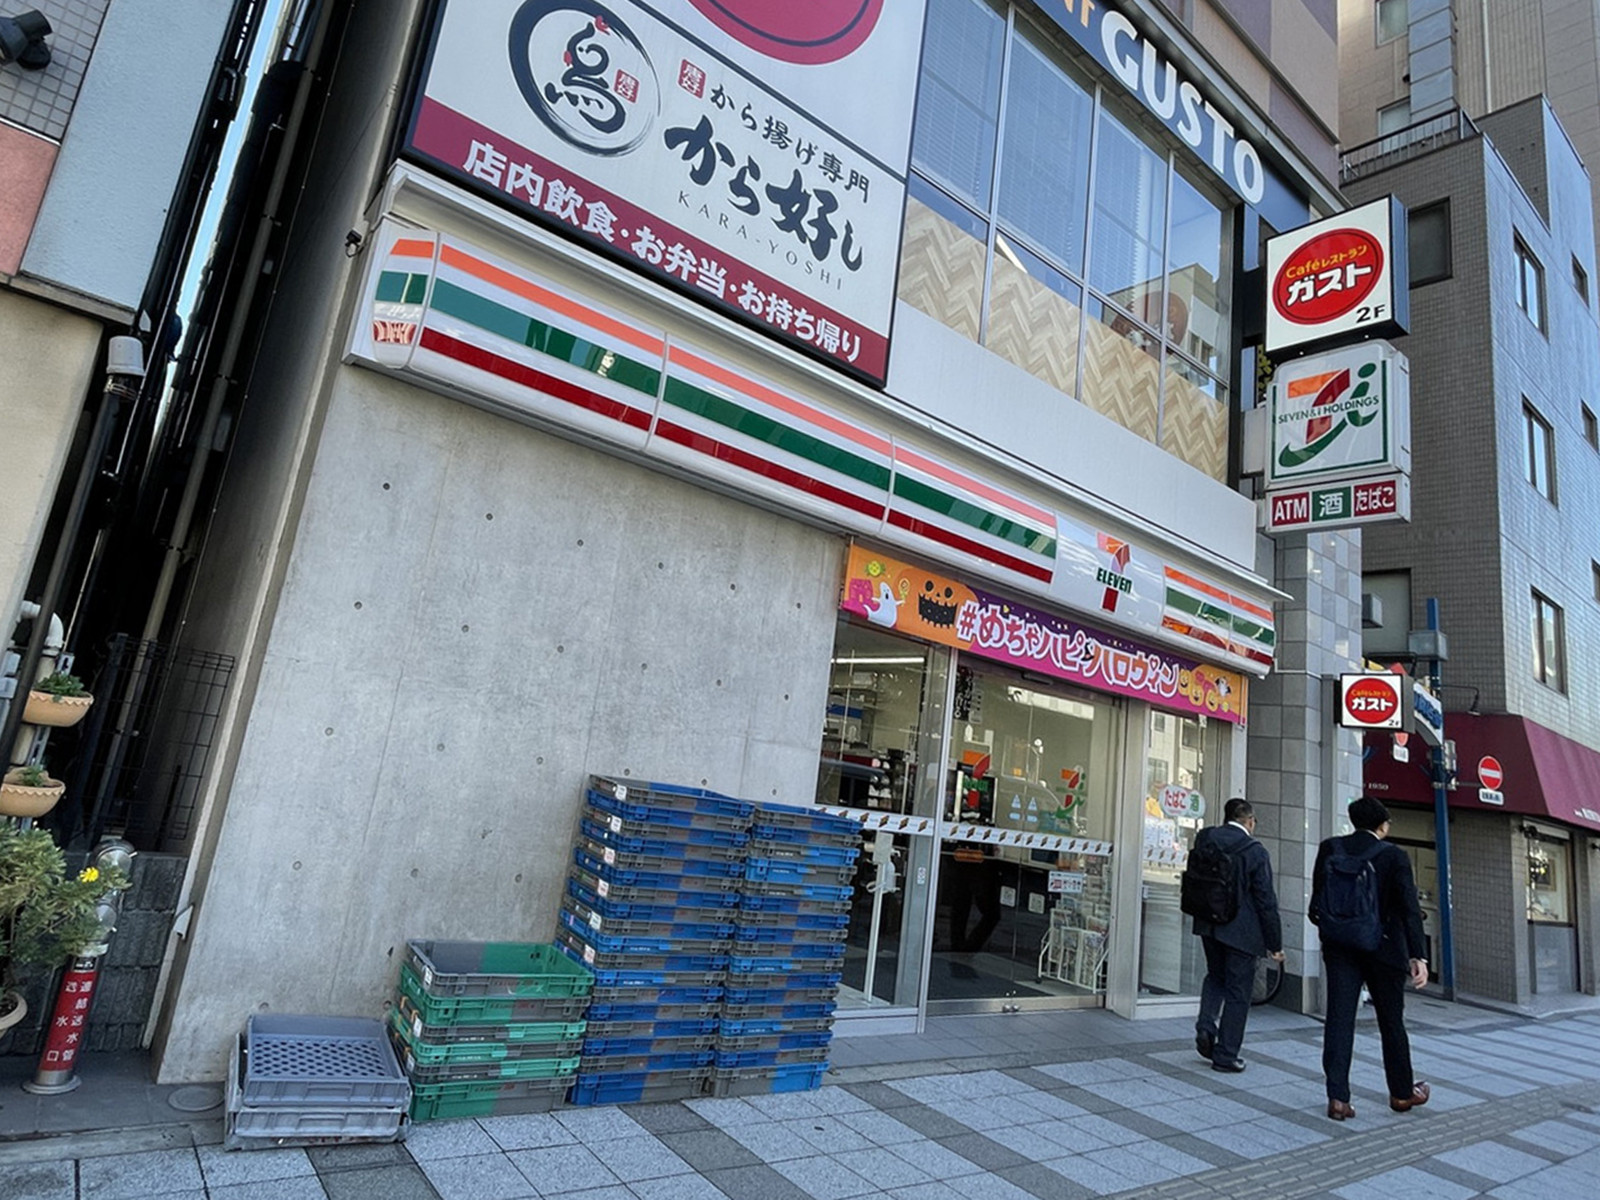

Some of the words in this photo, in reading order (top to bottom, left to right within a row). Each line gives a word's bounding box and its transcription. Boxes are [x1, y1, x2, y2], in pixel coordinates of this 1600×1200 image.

[1101, 10, 1264, 203] GUSTO
[710, 84, 869, 203] から揚げ専門
[664, 114, 863, 272] から好し
[678, 190, 842, 290] KARA-YOSHI
[1287, 262, 1372, 306] ガスト
[1356, 304, 1386, 324] 2F
[1323, 395, 1379, 415] HOLDINGS
[1274, 497, 1307, 521] ATM
[1319, 492, 1344, 517] 酒
[1355, 486, 1395, 511] たばこ
[1351, 697, 1393, 711] ガスト
